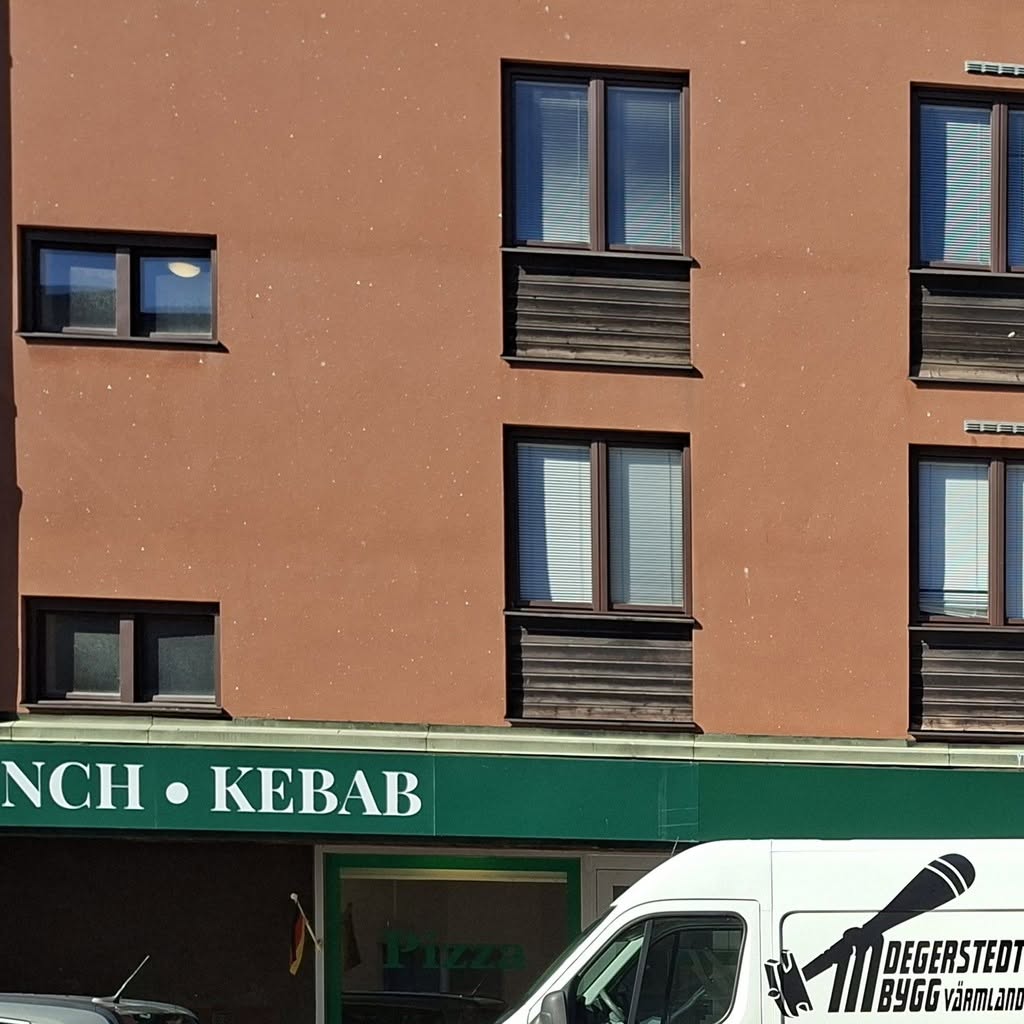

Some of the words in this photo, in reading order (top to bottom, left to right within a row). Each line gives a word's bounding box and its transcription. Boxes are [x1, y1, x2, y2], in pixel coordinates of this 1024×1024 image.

[1, 760, 144, 811] NCH
[210, 765, 422, 817] KEBAB
[383, 928, 527, 971] Pizza
[877, 978, 942, 1012] BYGG
